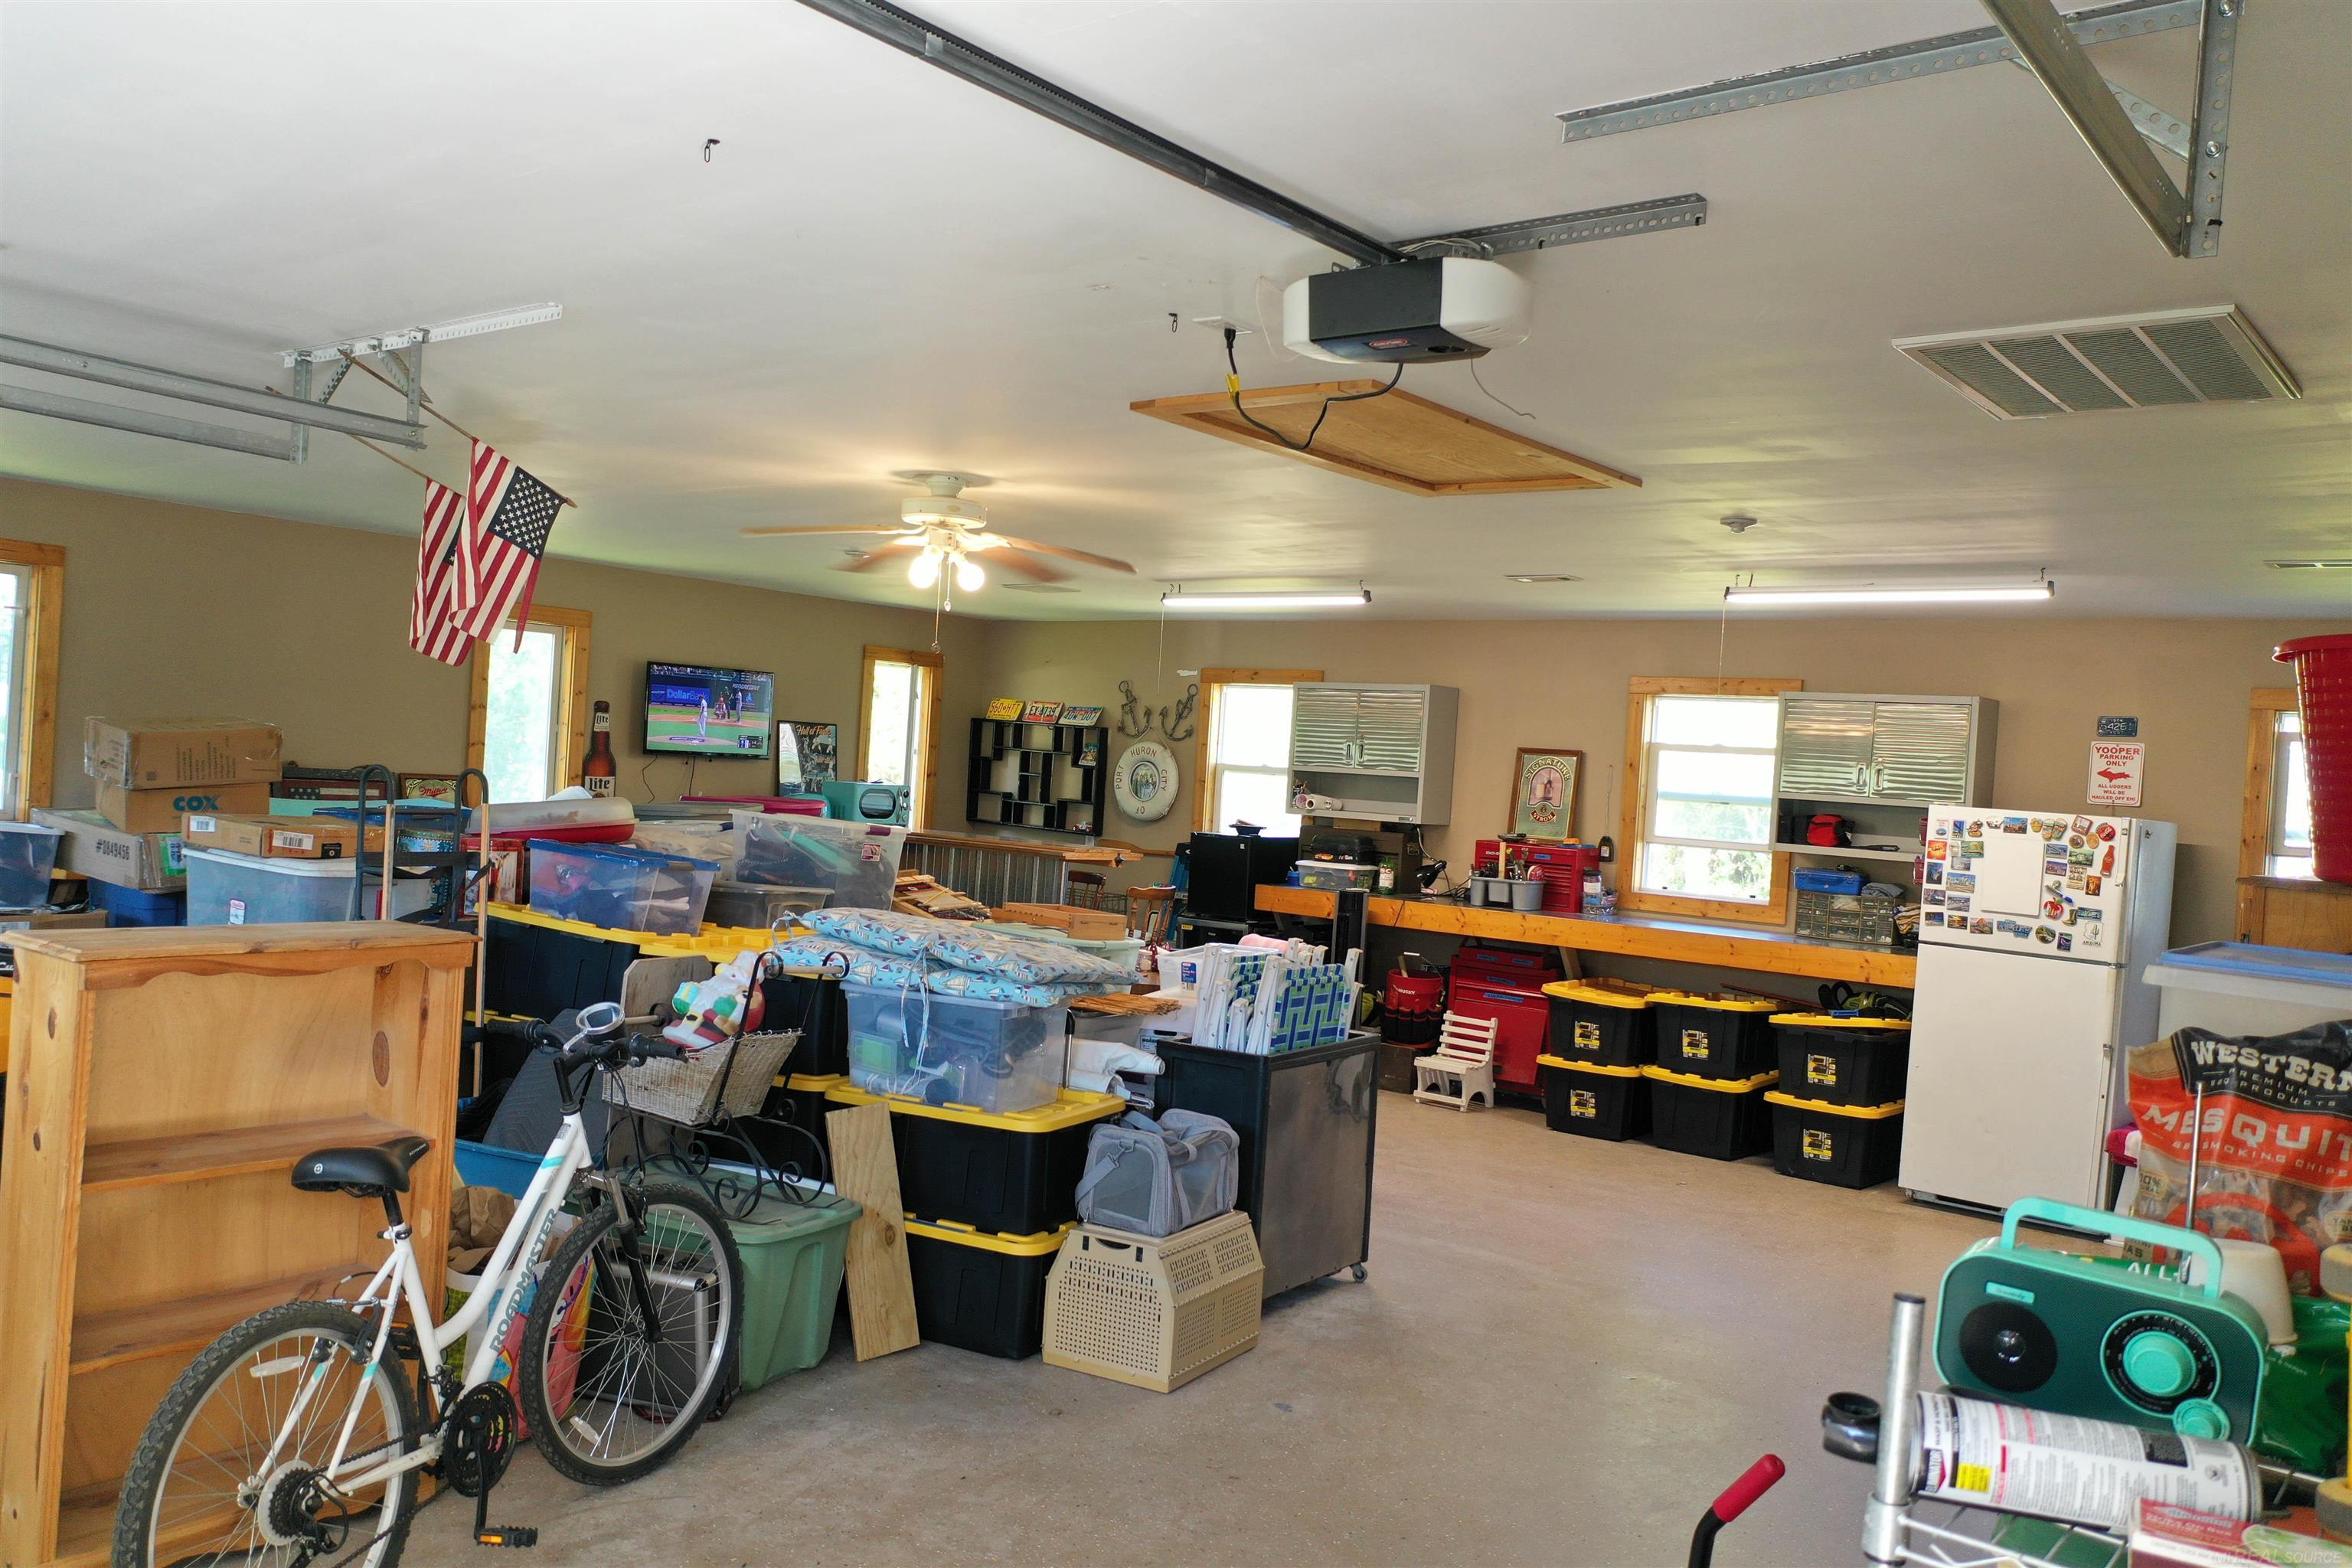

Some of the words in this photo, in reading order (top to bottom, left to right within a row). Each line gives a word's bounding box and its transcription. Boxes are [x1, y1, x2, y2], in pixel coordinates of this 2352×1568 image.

[596, 715, 609, 724] Lite
[809, 726, 817, 735] of
[1130, 746, 1157, 757] HURON
[2095, 746, 2141, 755] YOOPER
[1116, 764, 1124, 789] PORT
[1524, 758, 1571, 781] SIGNATURE
[588, 776, 610, 792] Lite
[172, 795, 220, 812] COX
[1135, 805, 1145, 815] OF
[1532, 812, 1553, 822] STROH
[2228, 1067, 2309, 1096] PREMIUM
[2240, 1080, 2336, 1107] PRODUCTS
[2202, 1141, 2286, 1162] SMOKING
[2295, 1159, 2349, 1178] CHIPS
[489, 1207, 557, 1353] ROADMASTER
